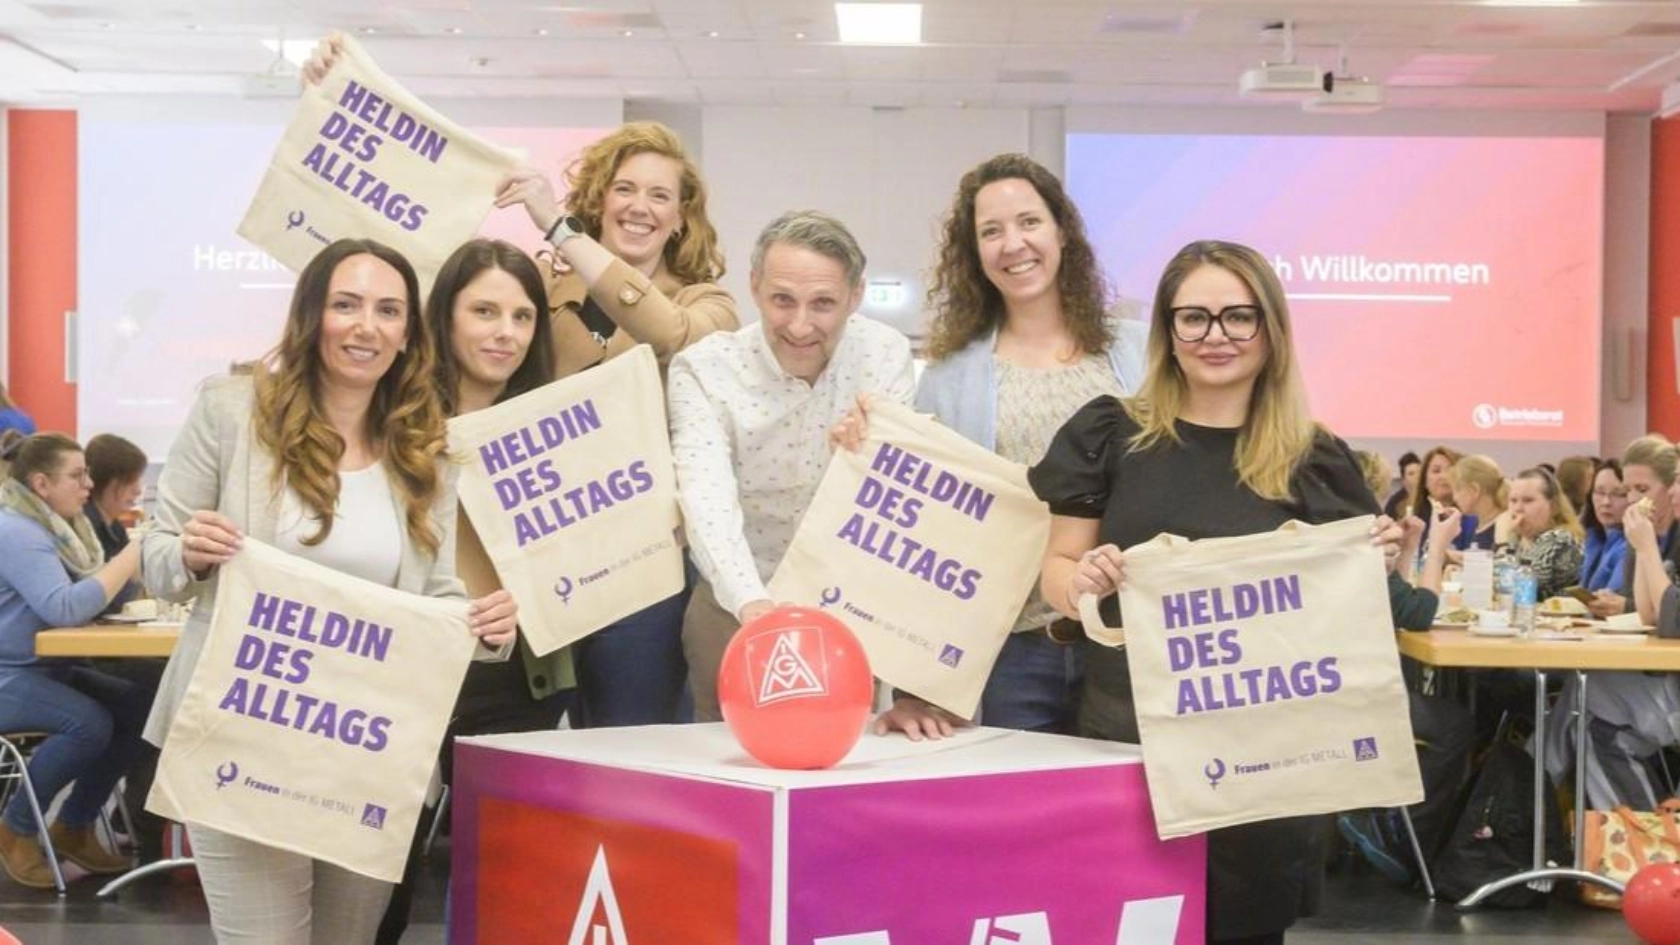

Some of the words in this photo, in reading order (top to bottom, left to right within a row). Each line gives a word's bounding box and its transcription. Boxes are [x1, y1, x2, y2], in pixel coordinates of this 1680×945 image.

[319, 111, 383, 162] DES
[338, 81, 448, 163] HELDIN
[302, 143, 428, 232] ALLTAGS
[1300, 255, 1490, 285] Willkommen
[478, 399, 602, 476] HELDIN
[494, 459, 562, 511] DES
[514, 460, 654, 548] ALLTAGS
[855, 476, 923, 529] DES
[871, 442, 995, 522] HELDIN
[579, 568, 610, 587] Frauen
[837, 513, 983, 600] ALLTAGS
[248, 592, 393, 662] HELDIN
[843, 602, 875, 623] Frauen
[1161, 574, 1303, 630] HELDIN
[234, 634, 315, 684] DES
[1167, 629, 1243, 672] DES
[1176, 657, 1342, 716] ALLTAGS
[218, 677, 393, 752] ALLTAGS
[244, 776, 280, 795] Frauen
[1234, 763, 1270, 775] Frauen
